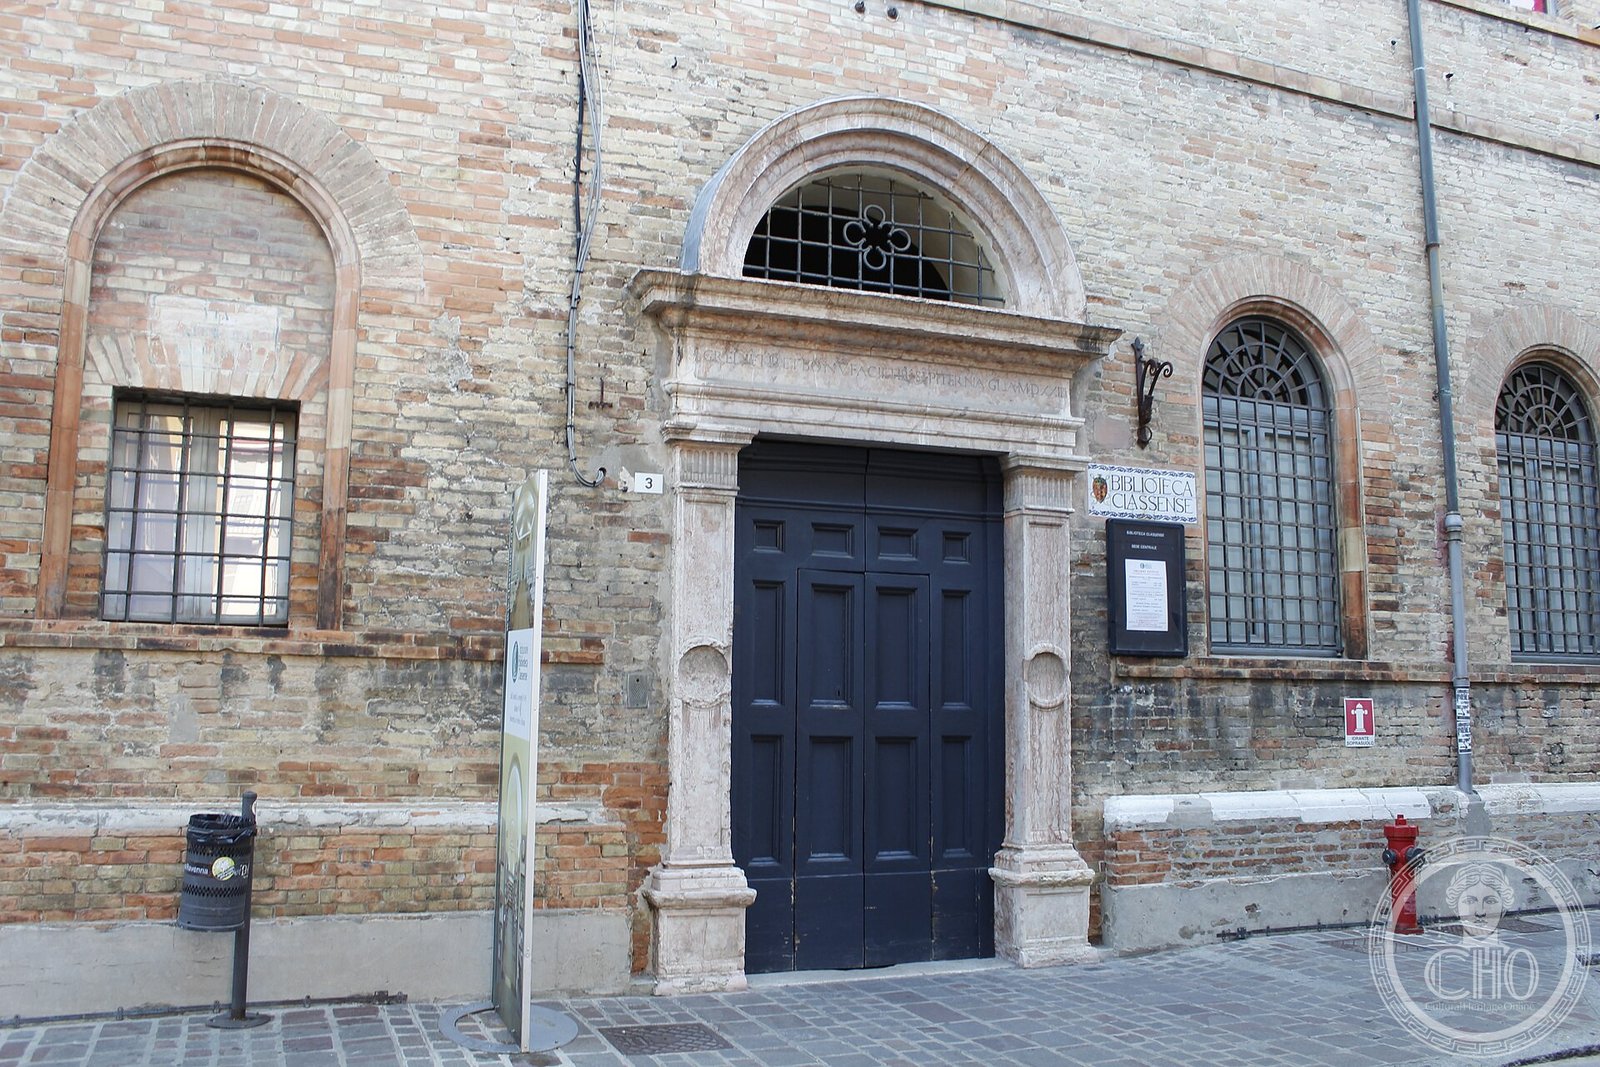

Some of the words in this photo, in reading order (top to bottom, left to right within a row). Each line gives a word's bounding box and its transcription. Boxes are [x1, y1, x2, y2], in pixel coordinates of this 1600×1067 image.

[645, 477, 653, 490] 3
[1111, 475, 1193, 497] BIBLIOTECA
[1111, 492, 1194, 514] CLASSENSE
